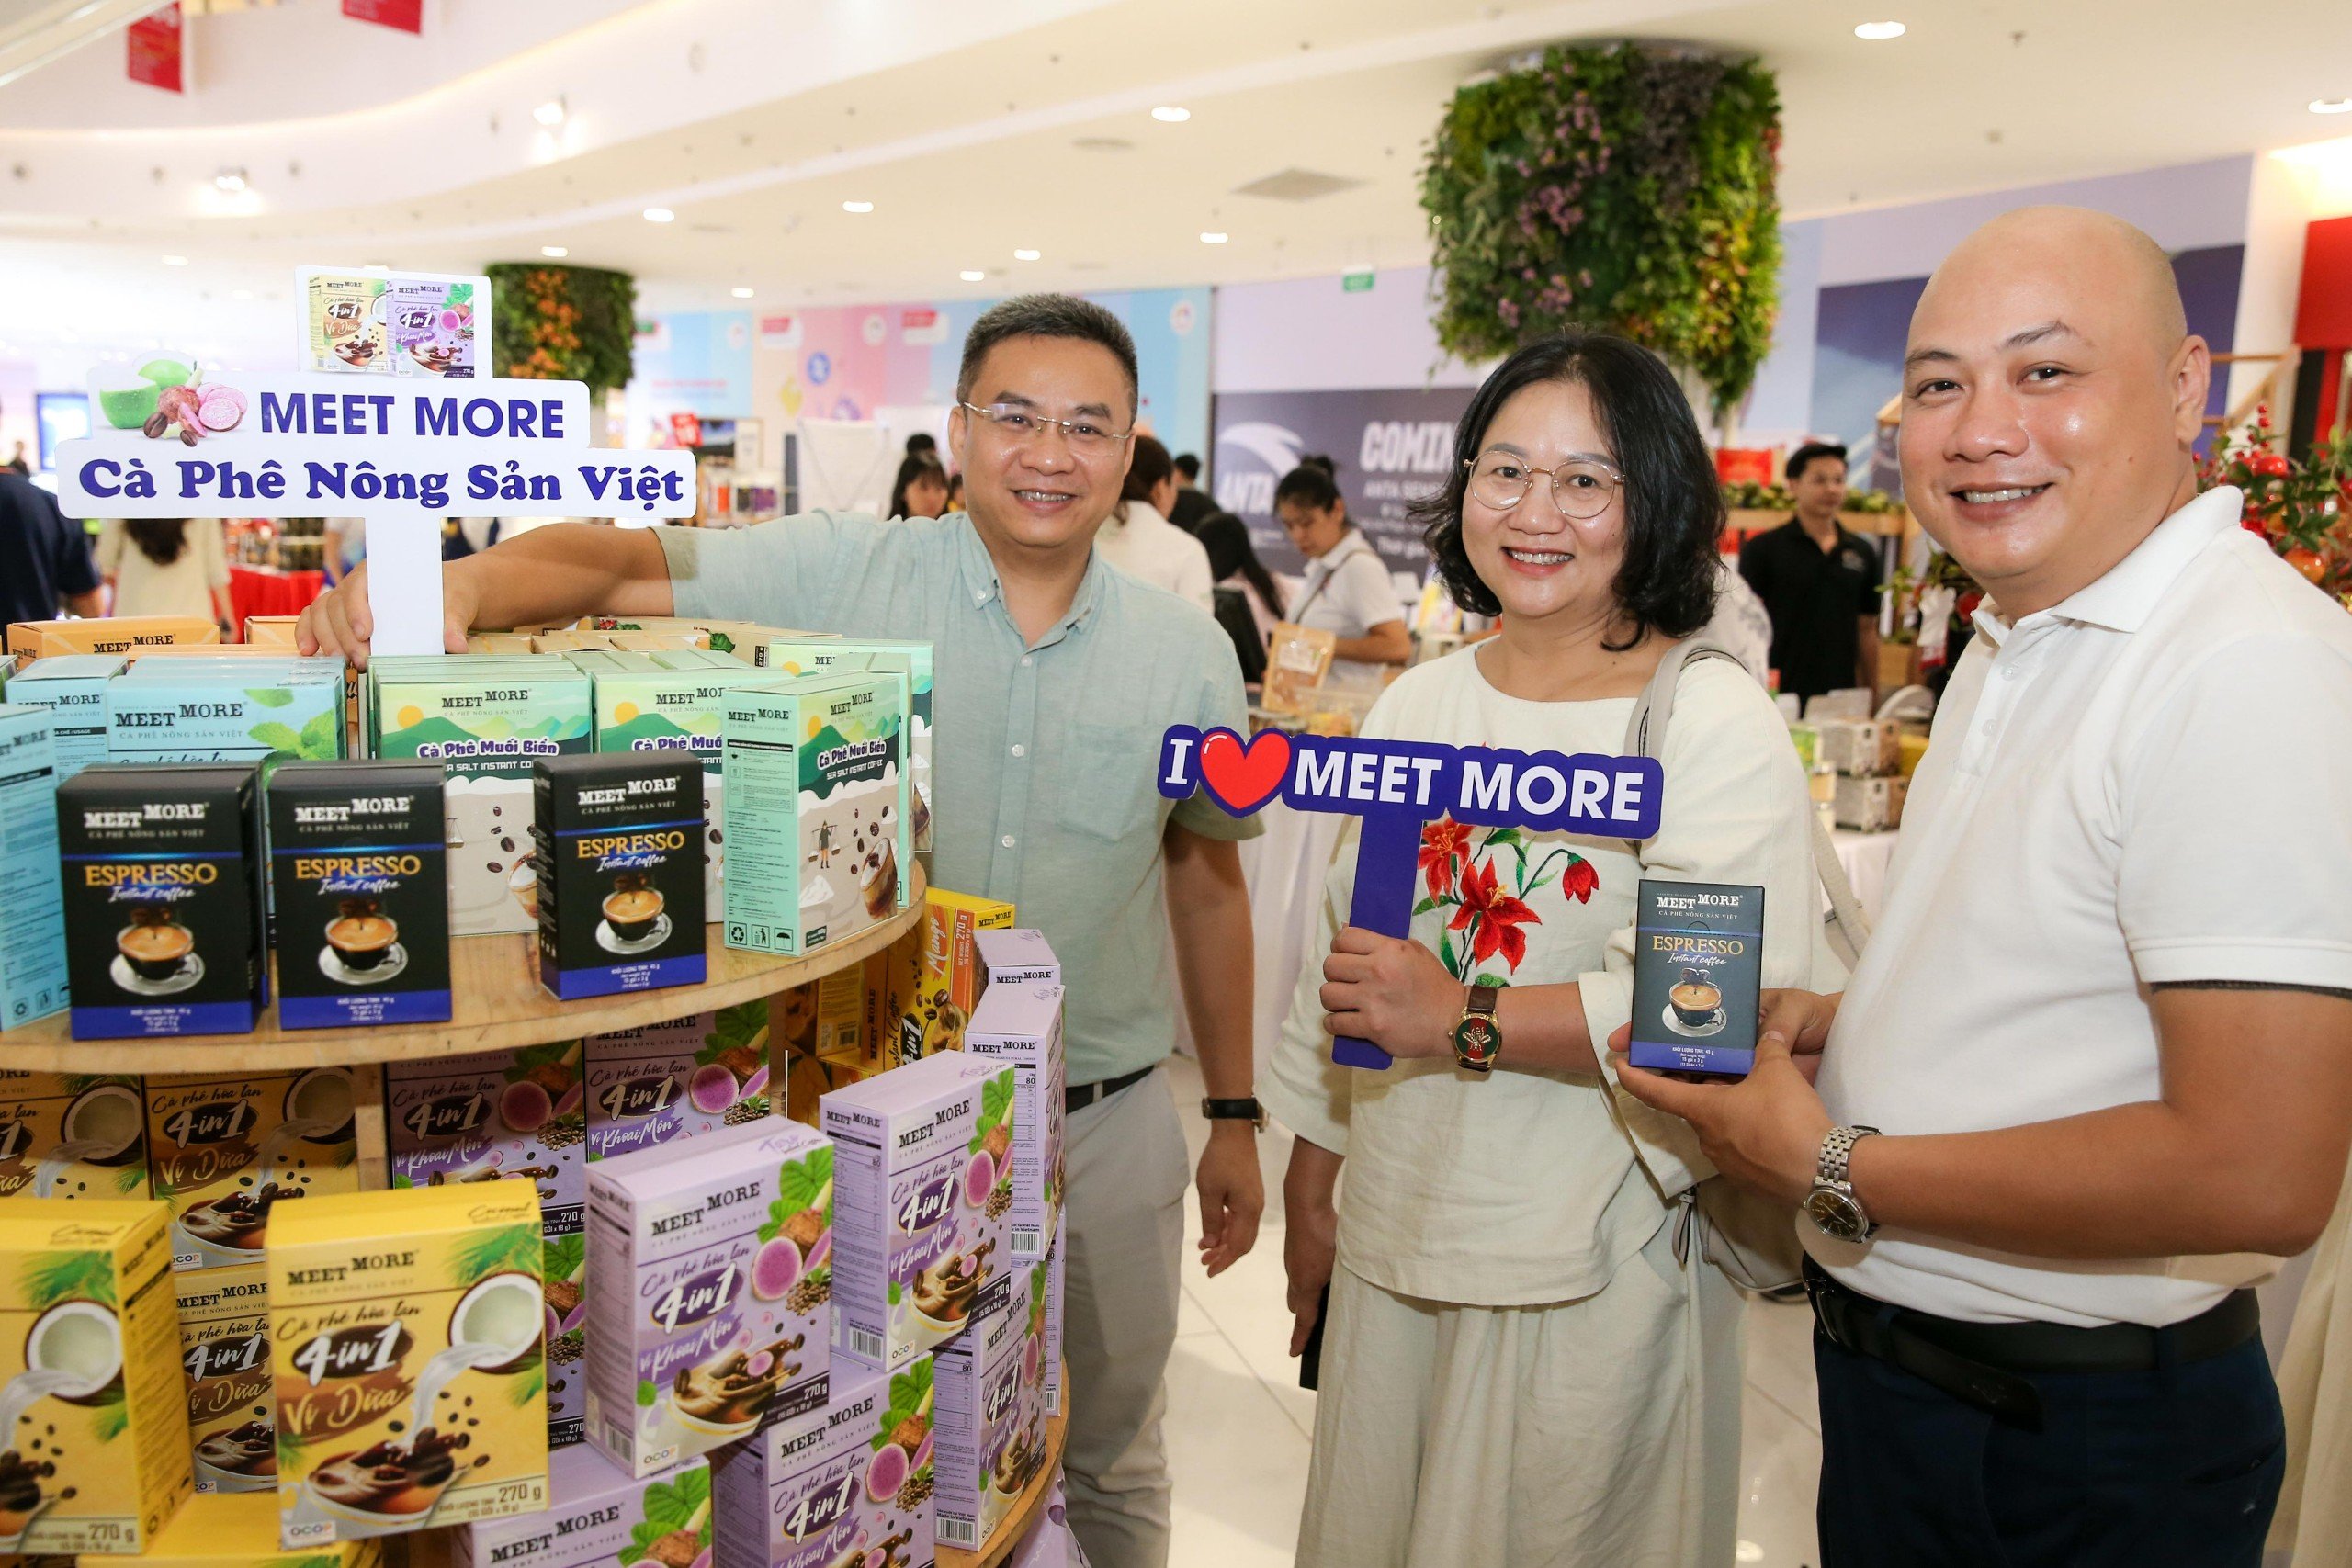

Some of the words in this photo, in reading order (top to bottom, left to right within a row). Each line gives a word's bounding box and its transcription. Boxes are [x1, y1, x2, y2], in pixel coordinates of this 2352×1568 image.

[261, 391, 395, 435] MEET
[415, 397, 564, 438] MORE
[79, 458, 157, 499] Cà
[176, 458, 286, 500] Phê
[305, 460, 449, 509] Nông
[466, 458, 562, 502] Sản
[578, 463, 684, 511] Việt
[94, 642, 131, 653] MEET
[133, 635, 174, 645] MORE
[59, 694, 100, 705] MORE
[442, 697, 482, 708] MEET
[486, 690, 528, 700] MORE
[831, 702, 851, 716] MEET
[852, 692, 873, 705] MORE
[115, 713, 175, 727] MEET
[179, 704, 243, 718] MORE
[728, 711, 756, 722] MEET
[758, 708, 789, 720] MORE
[419, 745, 439, 758] Cà
[444, 741, 476, 756] Phê
[481, 738, 518, 753] Muối
[524, 738, 557, 754] Biển
[819, 754, 829, 768] Cà
[832, 747, 847, 761] Phê
[849, 740, 867, 756] Muối
[869, 738, 885, 754] Biển
[456, 763, 478, 772] SALT
[481, 761, 516, 771] INSTANT
[827, 771, 836, 780] SEA
[837, 768, 848, 778] SALT
[849, 762, 866, 774] INSTANT
[867, 759, 883, 770] COFFEE
[1165, 739, 1193, 785] I
[1294, 749, 1442, 806] MEET
[1458, 761, 1645, 822] MORE
[578, 788, 626, 806] MEET
[628, 778, 676, 795] MORE
[84, 811, 142, 828] MEET
[143, 803, 205, 819] MORE
[295, 807, 350, 823] MEET
[351, 796, 410, 814] MORE
[577, 830, 685, 860] ESPRESSO
[85, 863, 218, 886] ESPRESSO
[294, 854, 421, 880] ESPRESSO
[596, 856, 635, 873] Instant
[635, 855, 667, 870] coffee
[108, 886, 154, 902] Instant
[155, 886, 196, 902] coffee
[318, 878, 361, 896] Instant
[361, 878, 400, 894] coffee
[1657, 897, 1695, 908] MEET
[1698, 894, 1739, 906] MORE
[979, 919, 994, 927] MEET
[995, 911, 1011, 919] MORE
[925, 915, 949, 977] Mango
[1653, 936, 1744, 954] ESPRESSO
[1668, 953, 1700, 964] Instant
[1700, 955, 1726, 966] coffee
[973, 1044, 1001, 1053] MEET
[1003, 1042, 1035, 1050] MORE
[589, 1067, 614, 1087] Cà
[617, 1064, 641, 1080] phê
[643, 1062, 665, 1077] hòa
[668, 1059, 690, 1076] tan
[152, 1095, 180, 1114] Cà
[182, 1090, 208, 1107] phê
[211, 1087, 237, 1100] hòa
[240, 1083, 264, 1099] tan
[393, 1087, 418, 1107] Cà
[422, 1084, 447, 1101] phê
[449, 1080, 473, 1095] hòa
[477, 1077, 497, 1093] tan
[603, 1075, 675, 1120] 4in1
[166, 1099, 248, 1149] 4in1
[408, 1092, 483, 1140] 4in1
[827, 1111, 852, 1126] MEET
[853, 1112, 880, 1128] MORE
[899, 1122, 934, 1149] MEET
[936, 1100, 970, 1124] MORE
[591, 1134, 600, 1147] Vị
[601, 1126, 642, 1157] Khoai
[642, 1119, 675, 1144] Môn
[159, 1157, 184, 1186] Vị
[193, 1147, 253, 1180] Dừa
[396, 1150, 406, 1168] Vị
[407, 1146, 449, 1178] Khoai
[448, 1139, 483, 1164] Môn
[561, 1211, 578, 1223] 270
[651, 1210, 704, 1237] MEET
[707, 1181, 761, 1212] MORE
[900, 1172, 956, 1239] 4in1
[899, 1238, 929, 1281] Khoai
[930, 1225, 953, 1257] Môn
[288, 1268, 348, 1286] MEET
[352, 1252, 414, 1272] MORE
[655, 1262, 736, 1335] 4in1
[988, 1319, 1007, 1350] MEET
[1007, 1290, 1026, 1321] MORE
[184, 1332, 263, 1382] 4in1
[296, 1320, 404, 1387] 4in1
[652, 1334, 696, 1382] Khoai
[697, 1319, 734, 1357] Môn
[209, 1381, 266, 1411] Dừa
[804, 1385, 820, 1400] 270
[989, 1359, 1019, 1427] 4in1
[284, 1395, 316, 1436] Vị
[326, 1383, 400, 1428] Dừa
[569, 1423, 583, 1434] 270
[781, 1428, 827, 1458] MEET
[828, 1397, 874, 1429] MORE
[498, 1483, 528, 1504] 270
[533, 1488, 542, 1500] g
[774, 1488, 798, 1514] Cà
[801, 1474, 822, 1497] phê
[826, 1463, 845, 1482] hòa
[845, 1455, 865, 1474] tan
[786, 1471, 854, 1545] 4in1
[88, 1522, 119, 1543] 270
[491, 1533, 553, 1563] MEET
[555, 1505, 620, 1538] MORE
[824, 1522, 854, 1557] Môn
